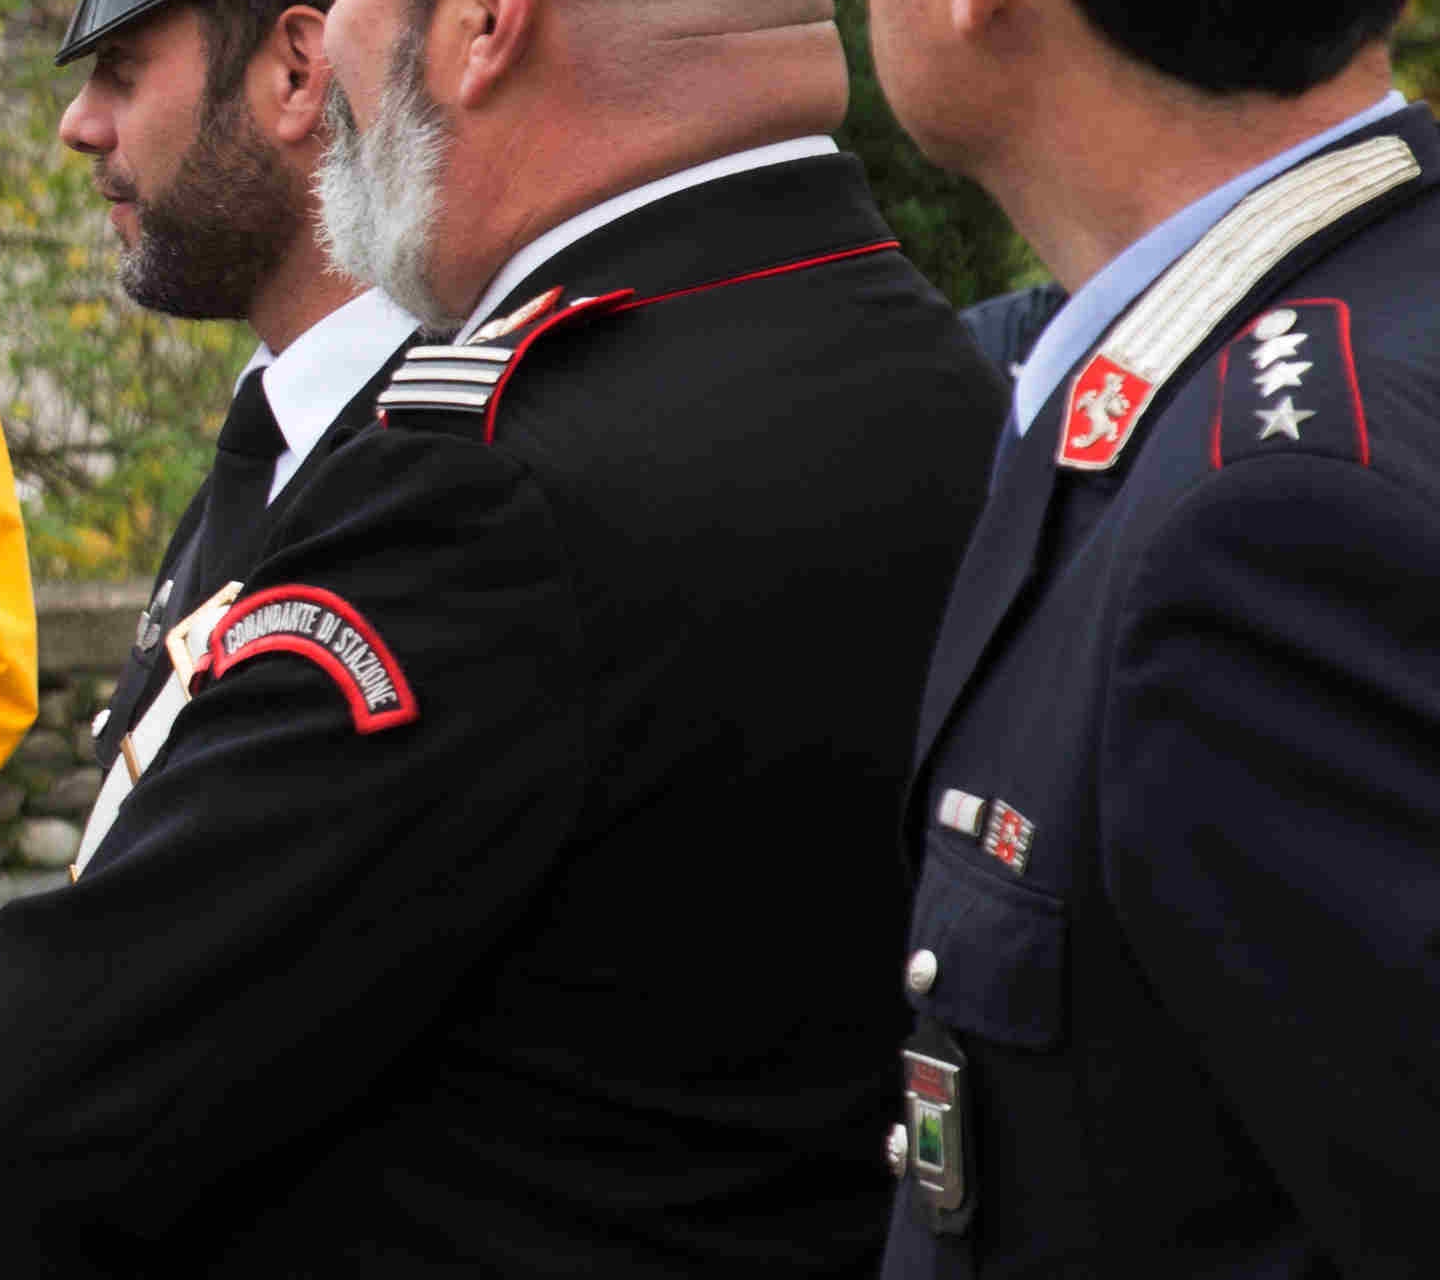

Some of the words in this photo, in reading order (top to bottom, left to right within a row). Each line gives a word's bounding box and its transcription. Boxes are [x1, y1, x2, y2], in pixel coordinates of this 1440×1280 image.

[225, 602, 322, 654] COMANDANTE
[318, 610, 343, 645] DI
[336, 626, 398, 712] STAZIONE
